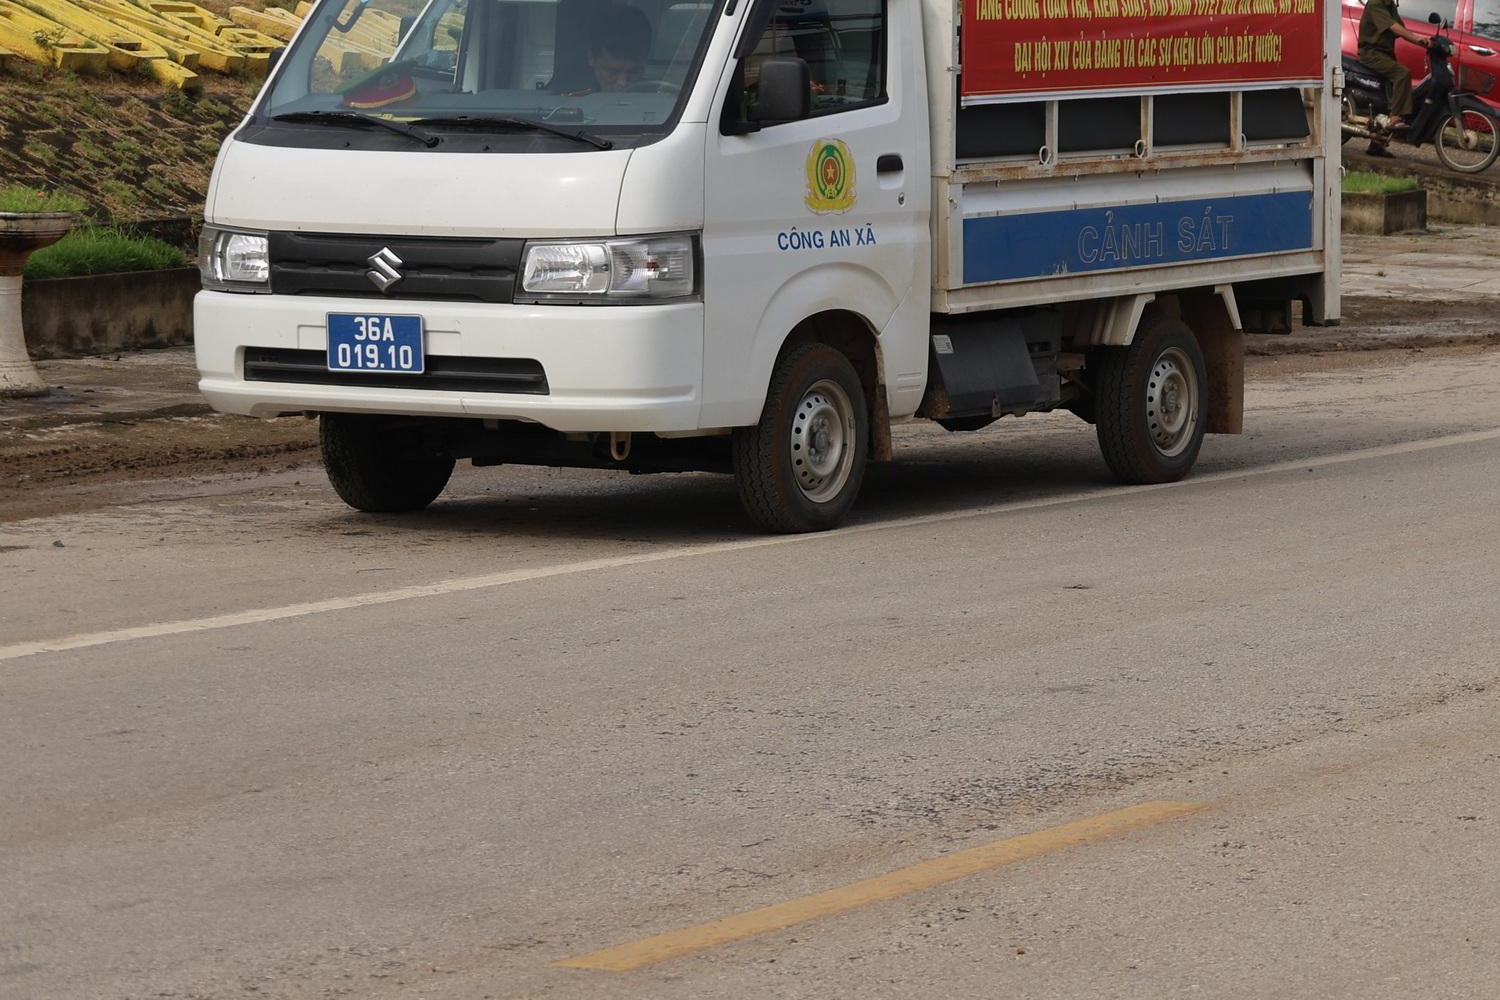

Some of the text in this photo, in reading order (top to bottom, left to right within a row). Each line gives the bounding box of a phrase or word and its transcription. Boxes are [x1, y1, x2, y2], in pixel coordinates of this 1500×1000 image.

[1014, 25, 1282, 79] ĐẠI HỘI XIV CỦA ĐẢNG VÀ CÁC SỰ KIỆN LỚN CỦA ĐẤT NƯỚC!
[777, 223, 876, 250] CÔNG AN XÃ
[1078, 206, 1234, 263] CẢNH SÁT
[354, 317, 394, 341] 36A
[338, 343, 412, 369] 019.10
